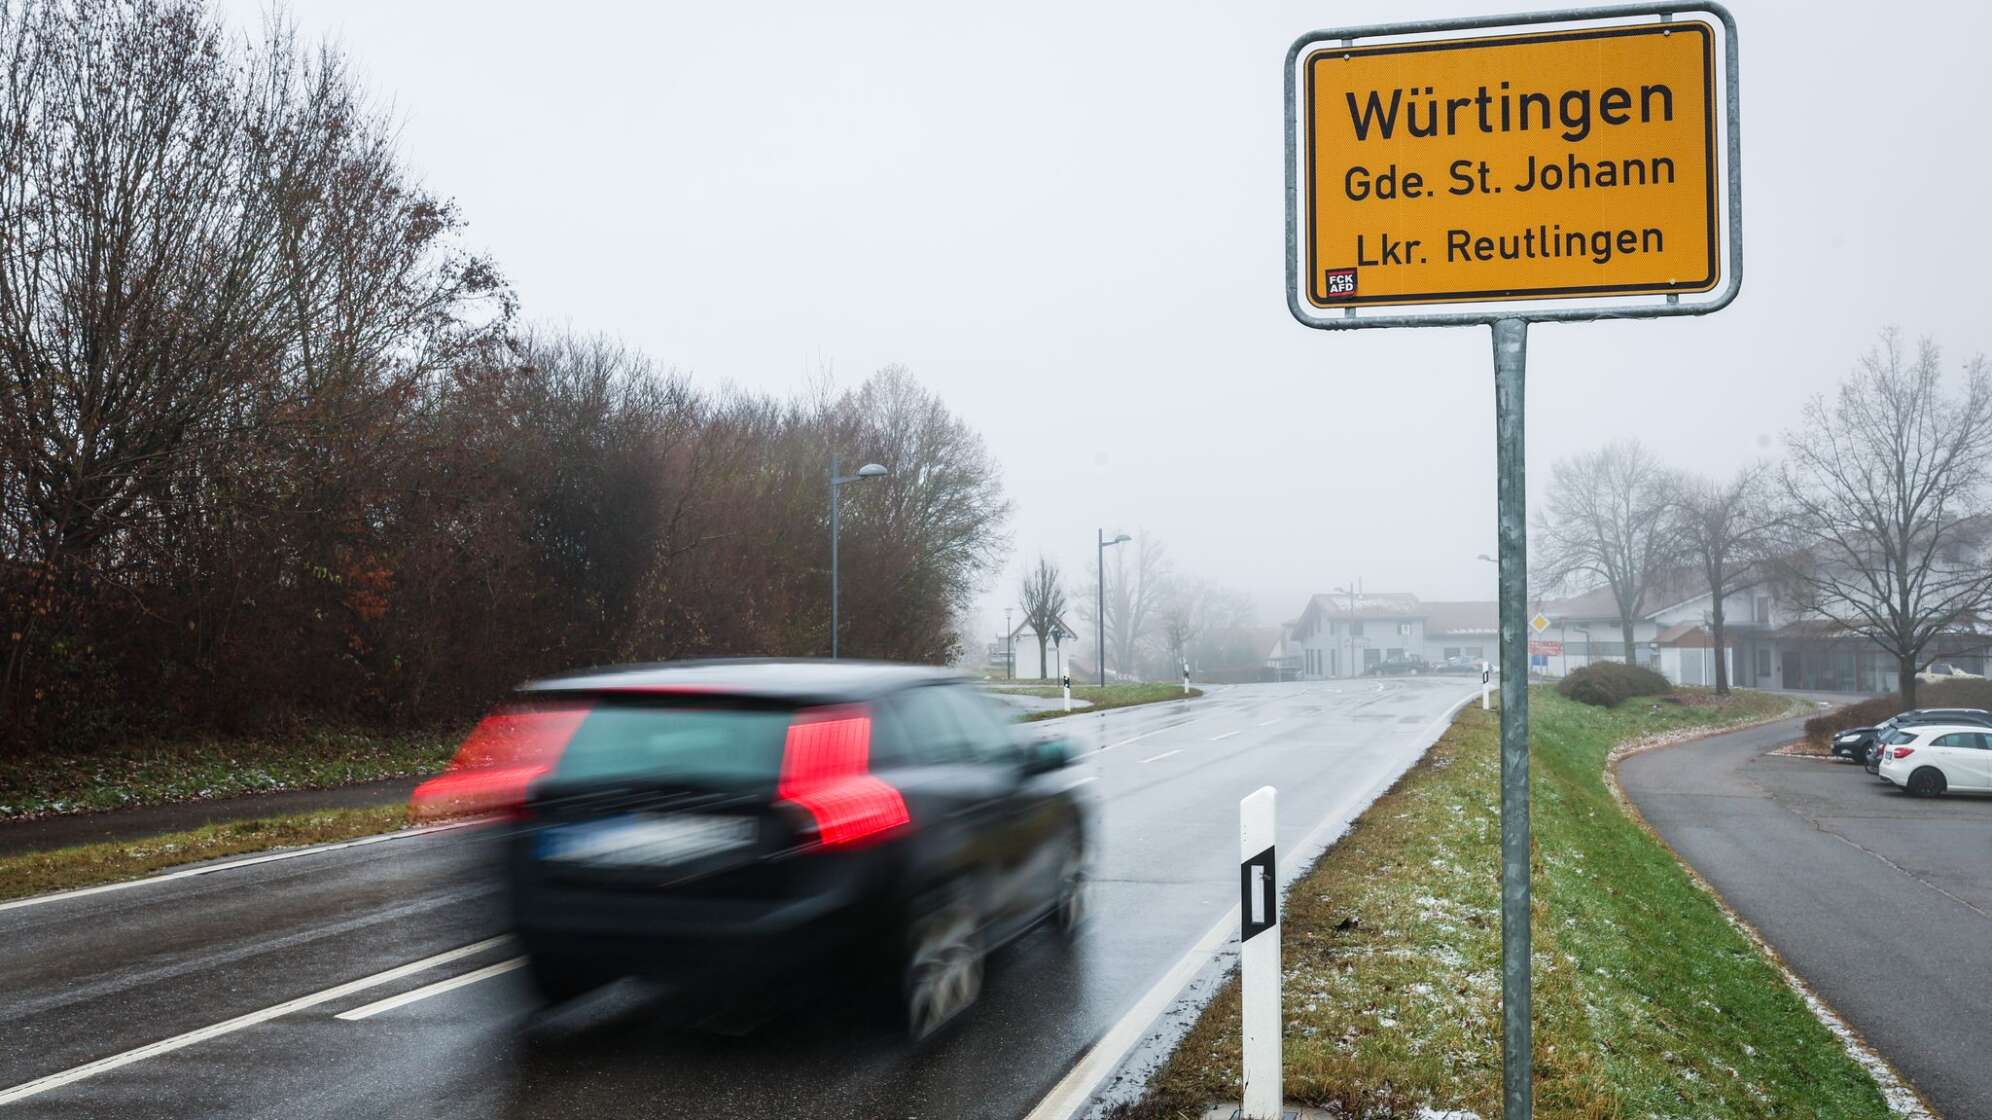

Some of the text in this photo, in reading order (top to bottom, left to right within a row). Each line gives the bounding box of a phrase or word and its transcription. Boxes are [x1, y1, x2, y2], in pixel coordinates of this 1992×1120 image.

[1345, 81, 1674, 142] Würtingen
[1345, 153, 1675, 202] Gde. St. Johann
[1357, 224, 1664, 267] Lkr. Reutlingen
[1329, 274, 1353, 284] FCK
[1330, 283, 1354, 293] AFD
